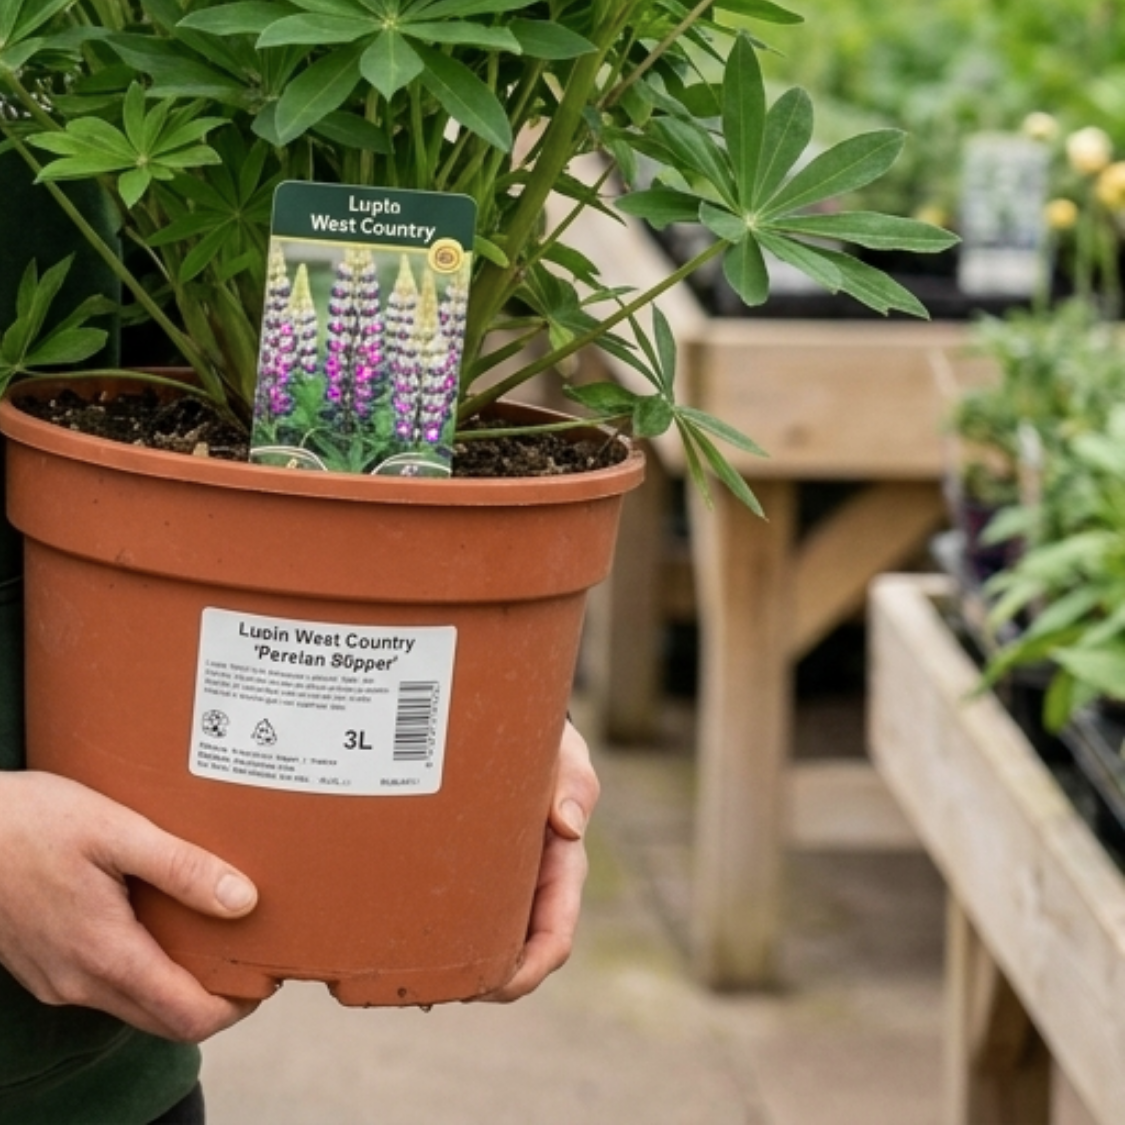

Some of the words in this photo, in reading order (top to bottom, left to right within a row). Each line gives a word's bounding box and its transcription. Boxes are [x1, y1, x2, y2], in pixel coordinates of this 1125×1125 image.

[310, 213, 357, 234] West
[360, 217, 436, 244] Country
[295, 628, 341, 647] West
[345, 632, 416, 654] Country
[343, 729, 373, 750] 3L
